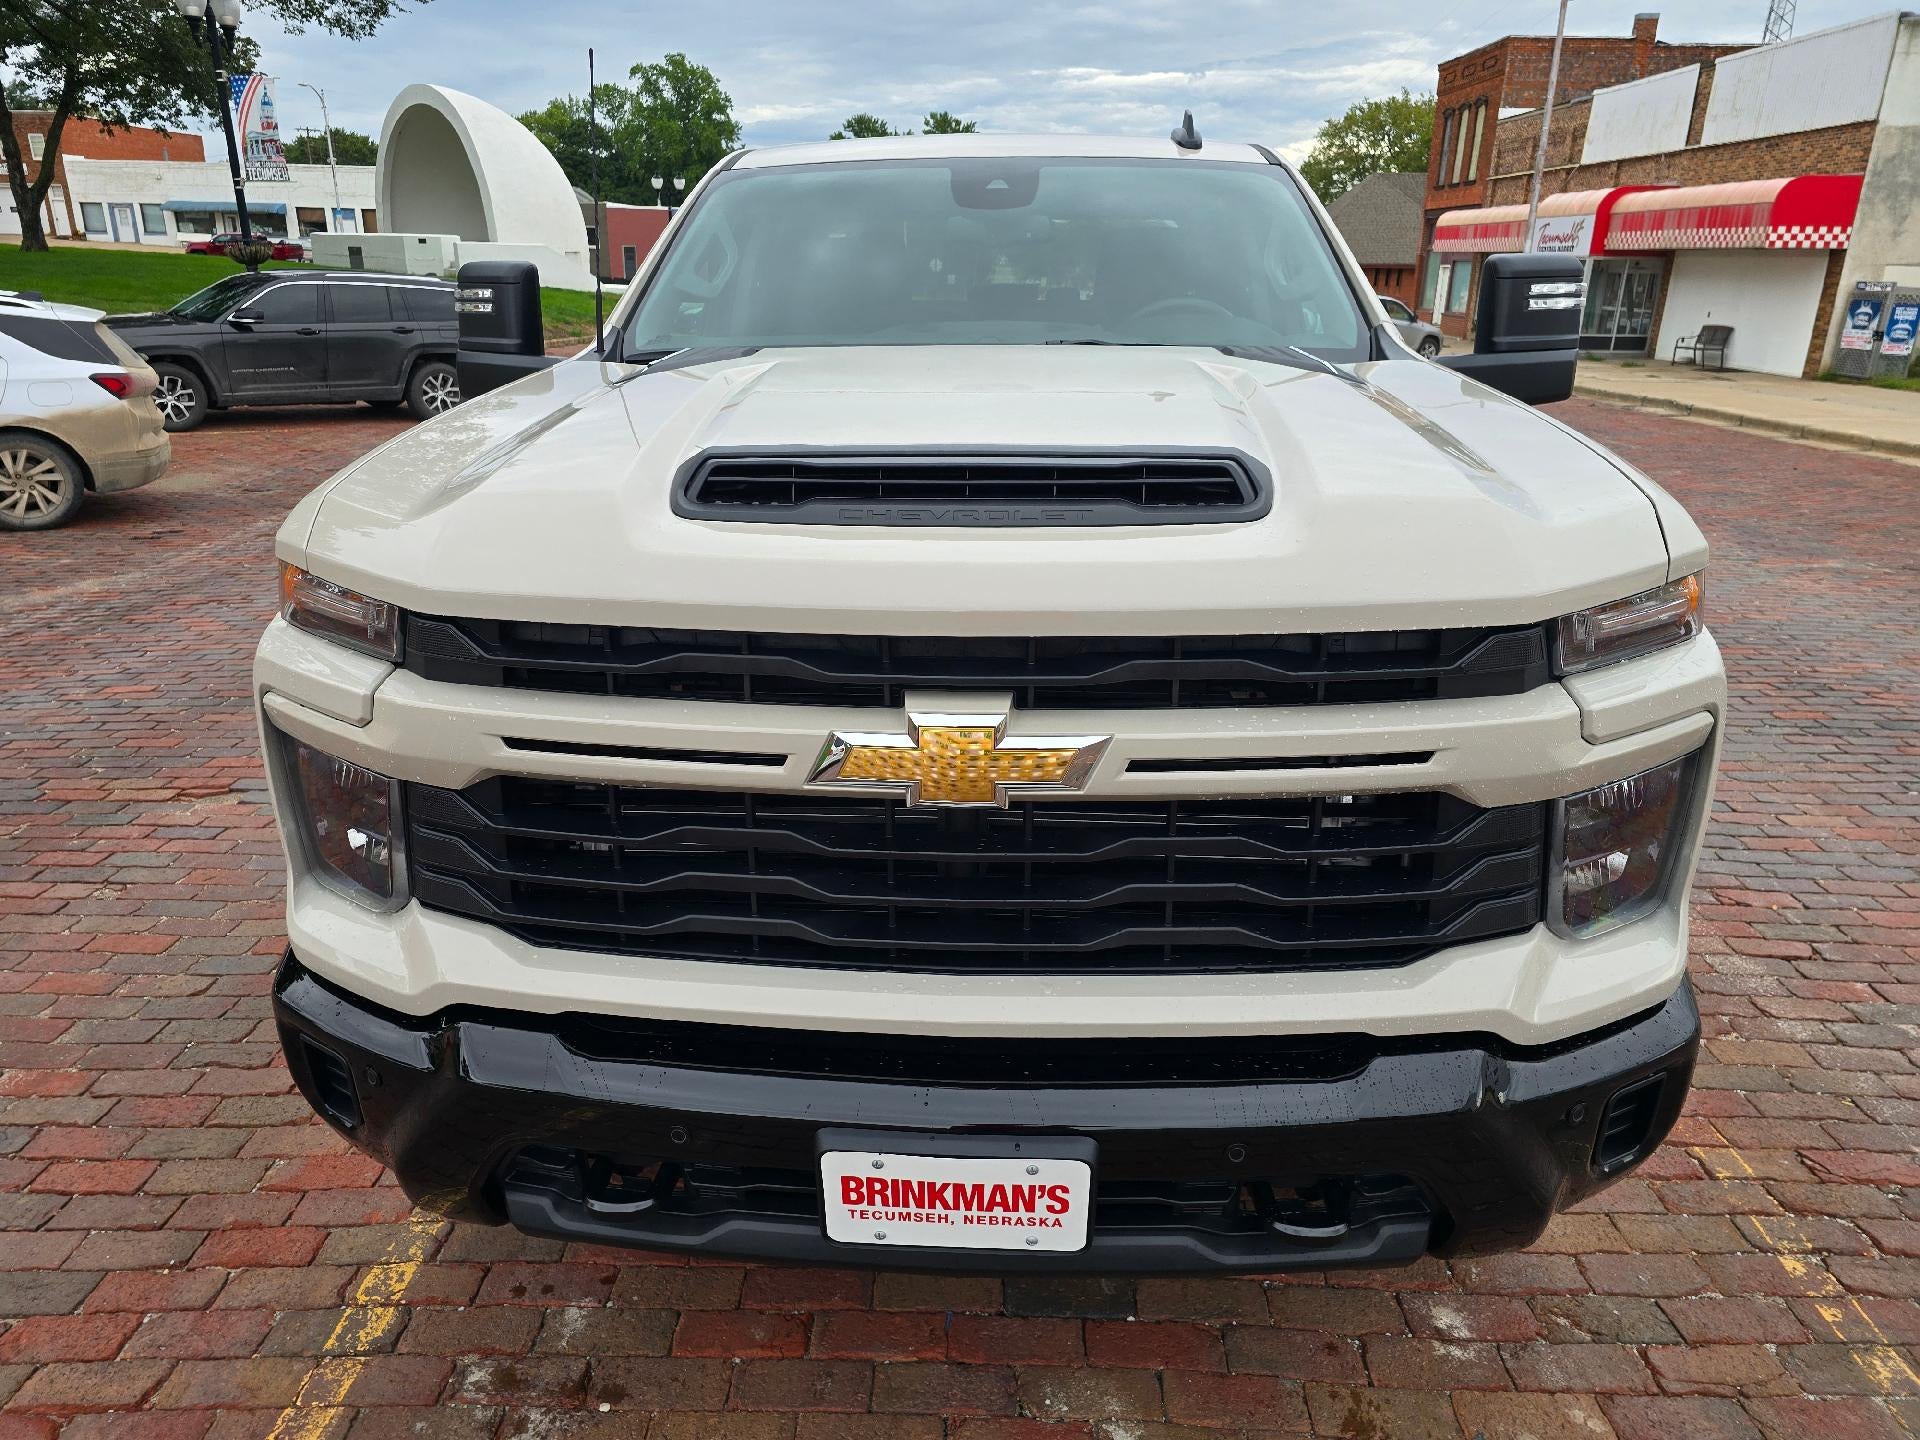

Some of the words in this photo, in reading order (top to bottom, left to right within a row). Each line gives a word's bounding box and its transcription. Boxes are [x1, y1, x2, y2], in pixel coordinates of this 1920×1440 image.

[246, 167, 289, 181] TECUMSEH
[838, 508, 1093, 521] CHEVROLET
[840, 1175, 1070, 1214] BRINKMAN'S
[848, 1209, 955, 1226] TECUMSEH,
[963, 1215, 1063, 1228] NEBRASKA
